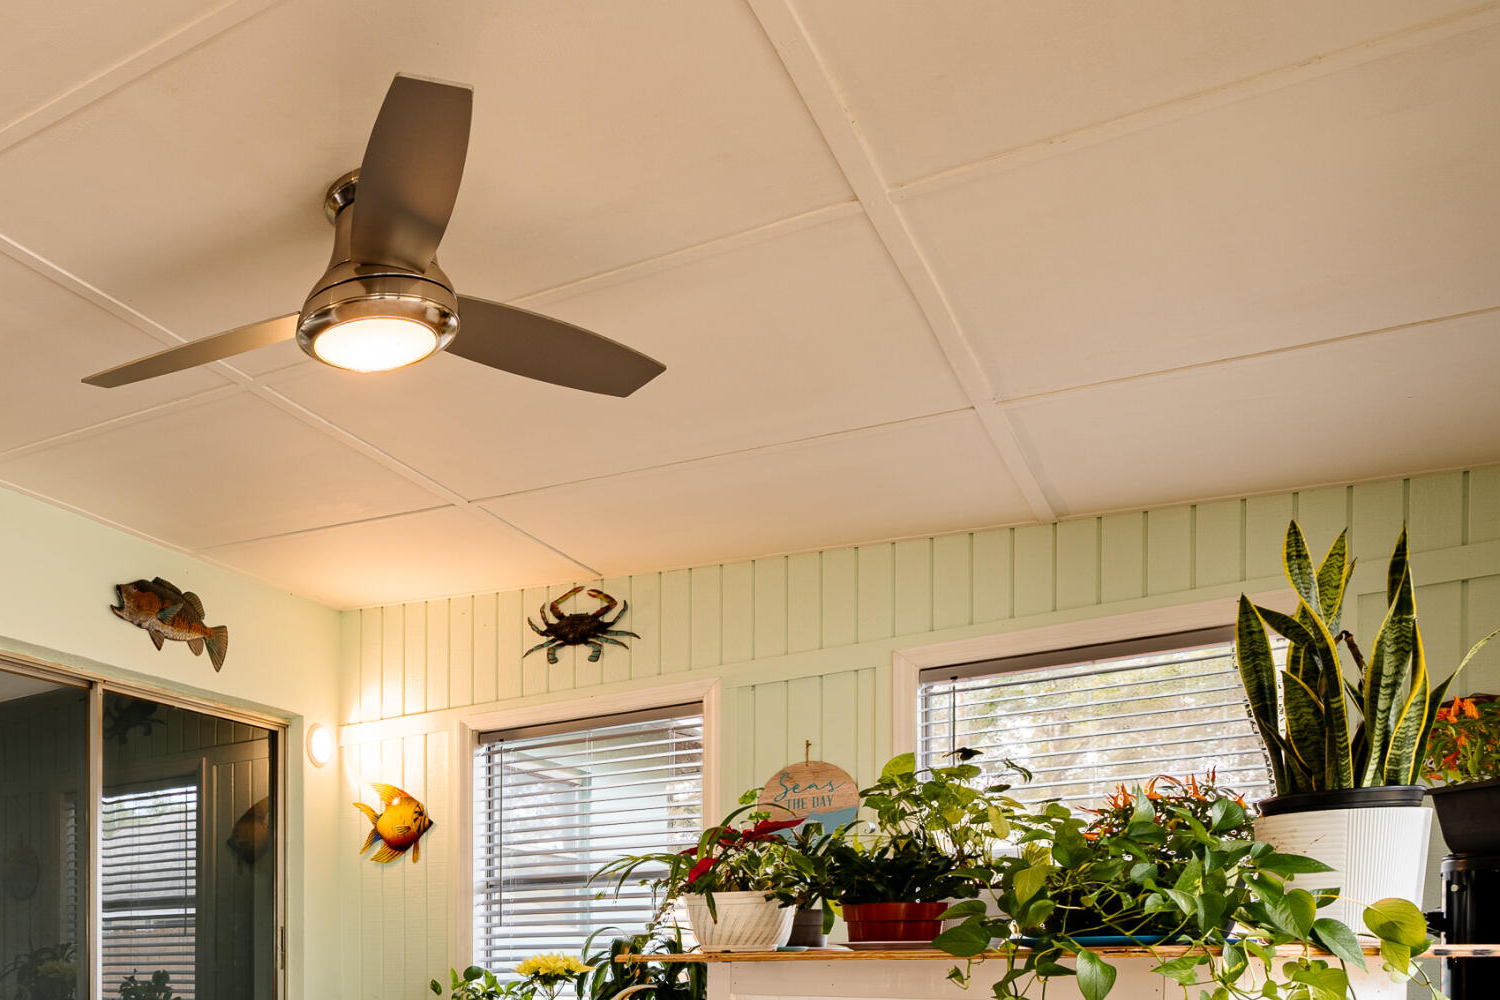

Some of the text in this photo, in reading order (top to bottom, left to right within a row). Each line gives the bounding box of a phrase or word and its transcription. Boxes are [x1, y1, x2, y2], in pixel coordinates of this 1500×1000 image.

[774, 772, 846, 802] Seas
[785, 795, 835, 810] THE DAY
